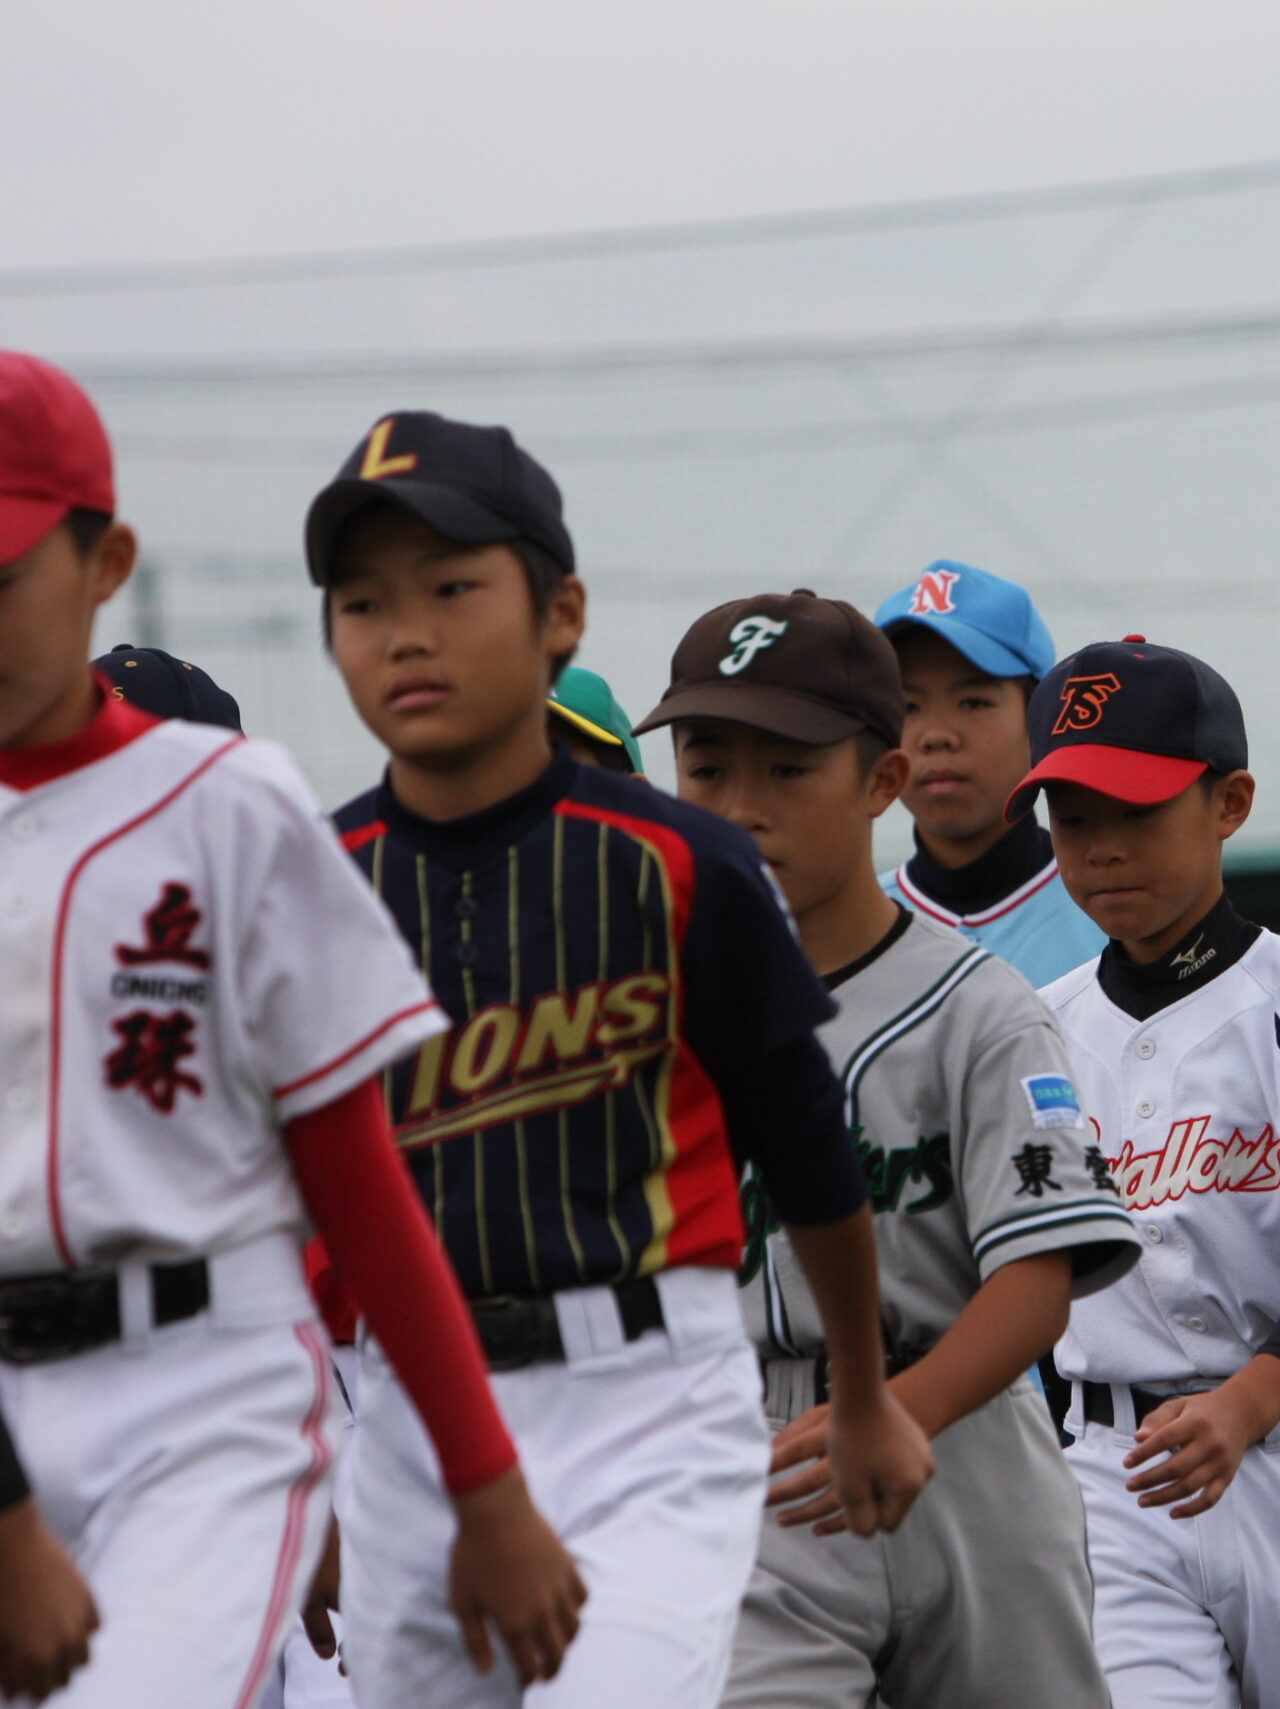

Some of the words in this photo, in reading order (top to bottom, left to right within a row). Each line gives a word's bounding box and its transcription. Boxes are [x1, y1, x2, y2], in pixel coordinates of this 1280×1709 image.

[358, 416, 419, 481] L
[908, 569, 961, 616] N
[718, 614, 789, 676] F
[404, 972, 674, 1119] IONS
